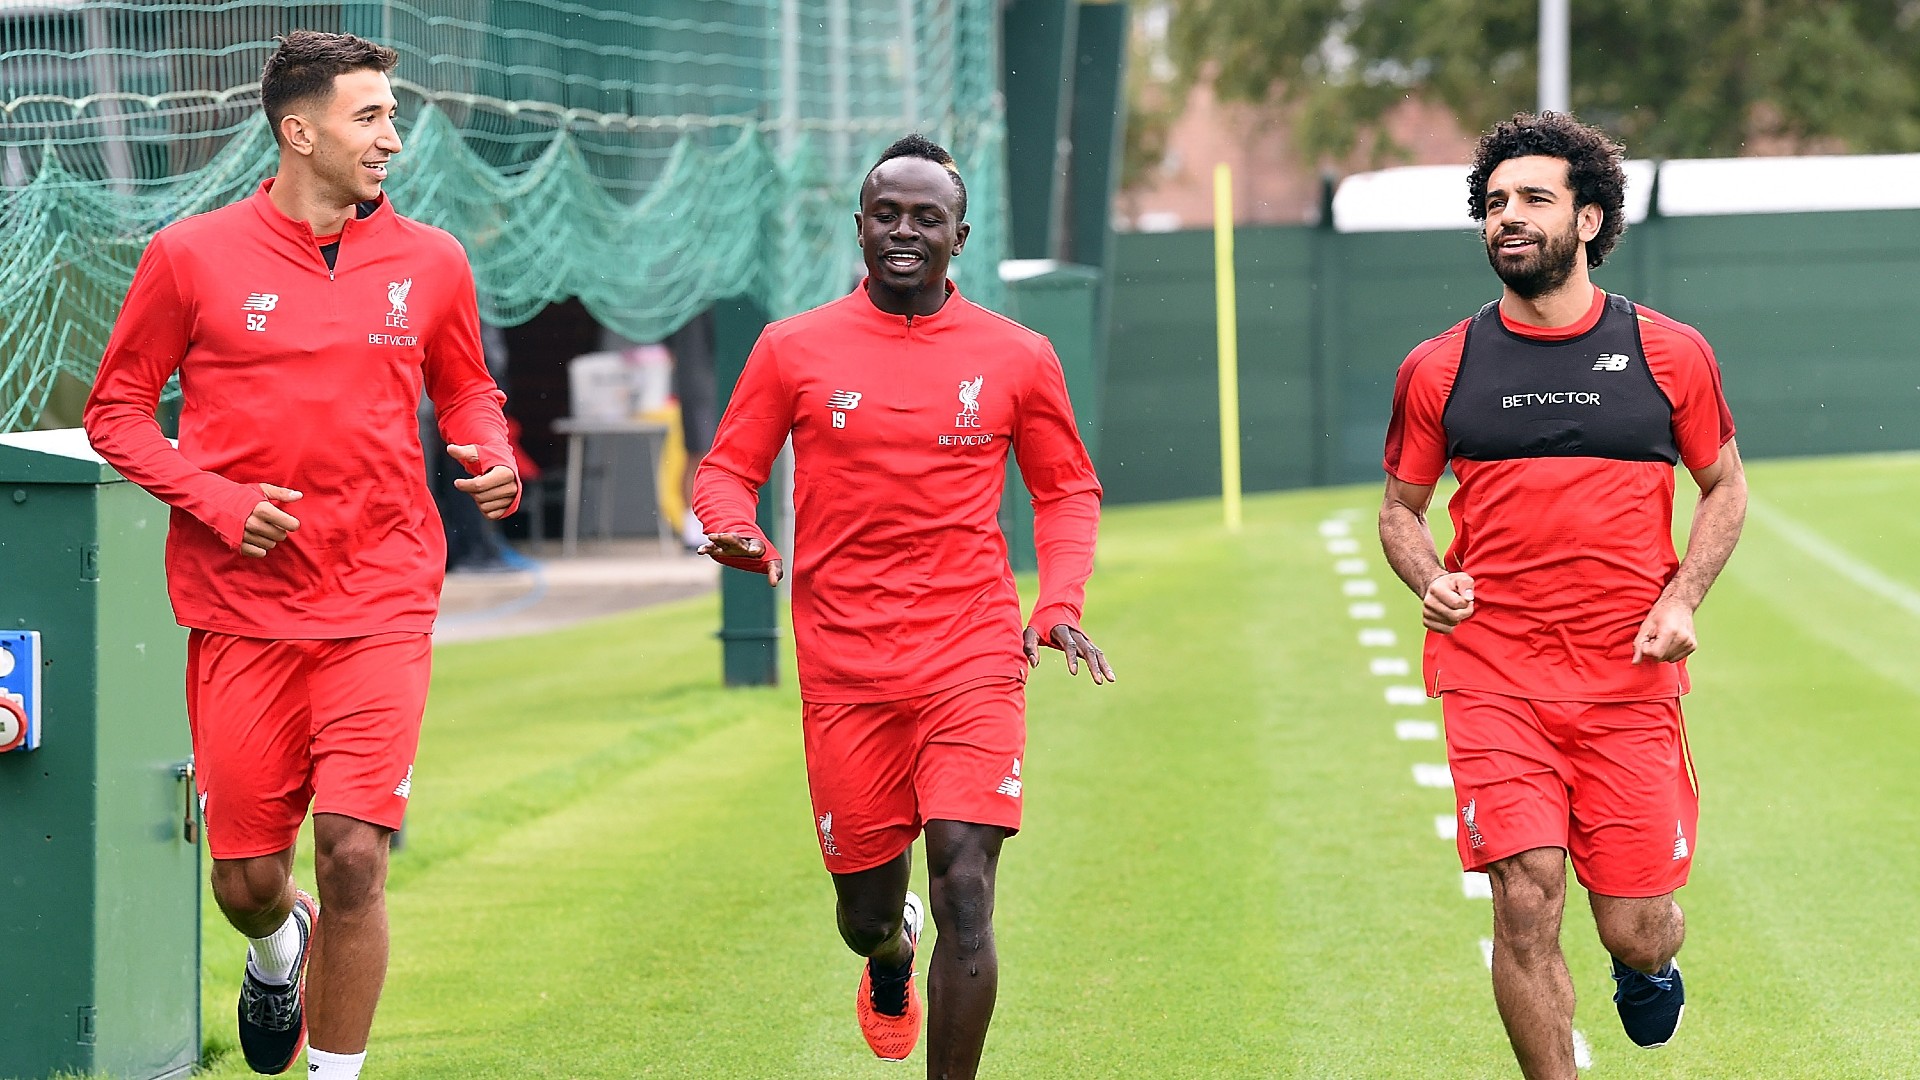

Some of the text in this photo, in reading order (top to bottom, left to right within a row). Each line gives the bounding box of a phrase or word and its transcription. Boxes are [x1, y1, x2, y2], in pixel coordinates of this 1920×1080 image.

[246, 313, 267, 332] 52
[1502, 391, 1601, 409] BETVICTOR
[832, 411, 847, 429] 19
[938, 433, 994, 446] BETVICTOR
